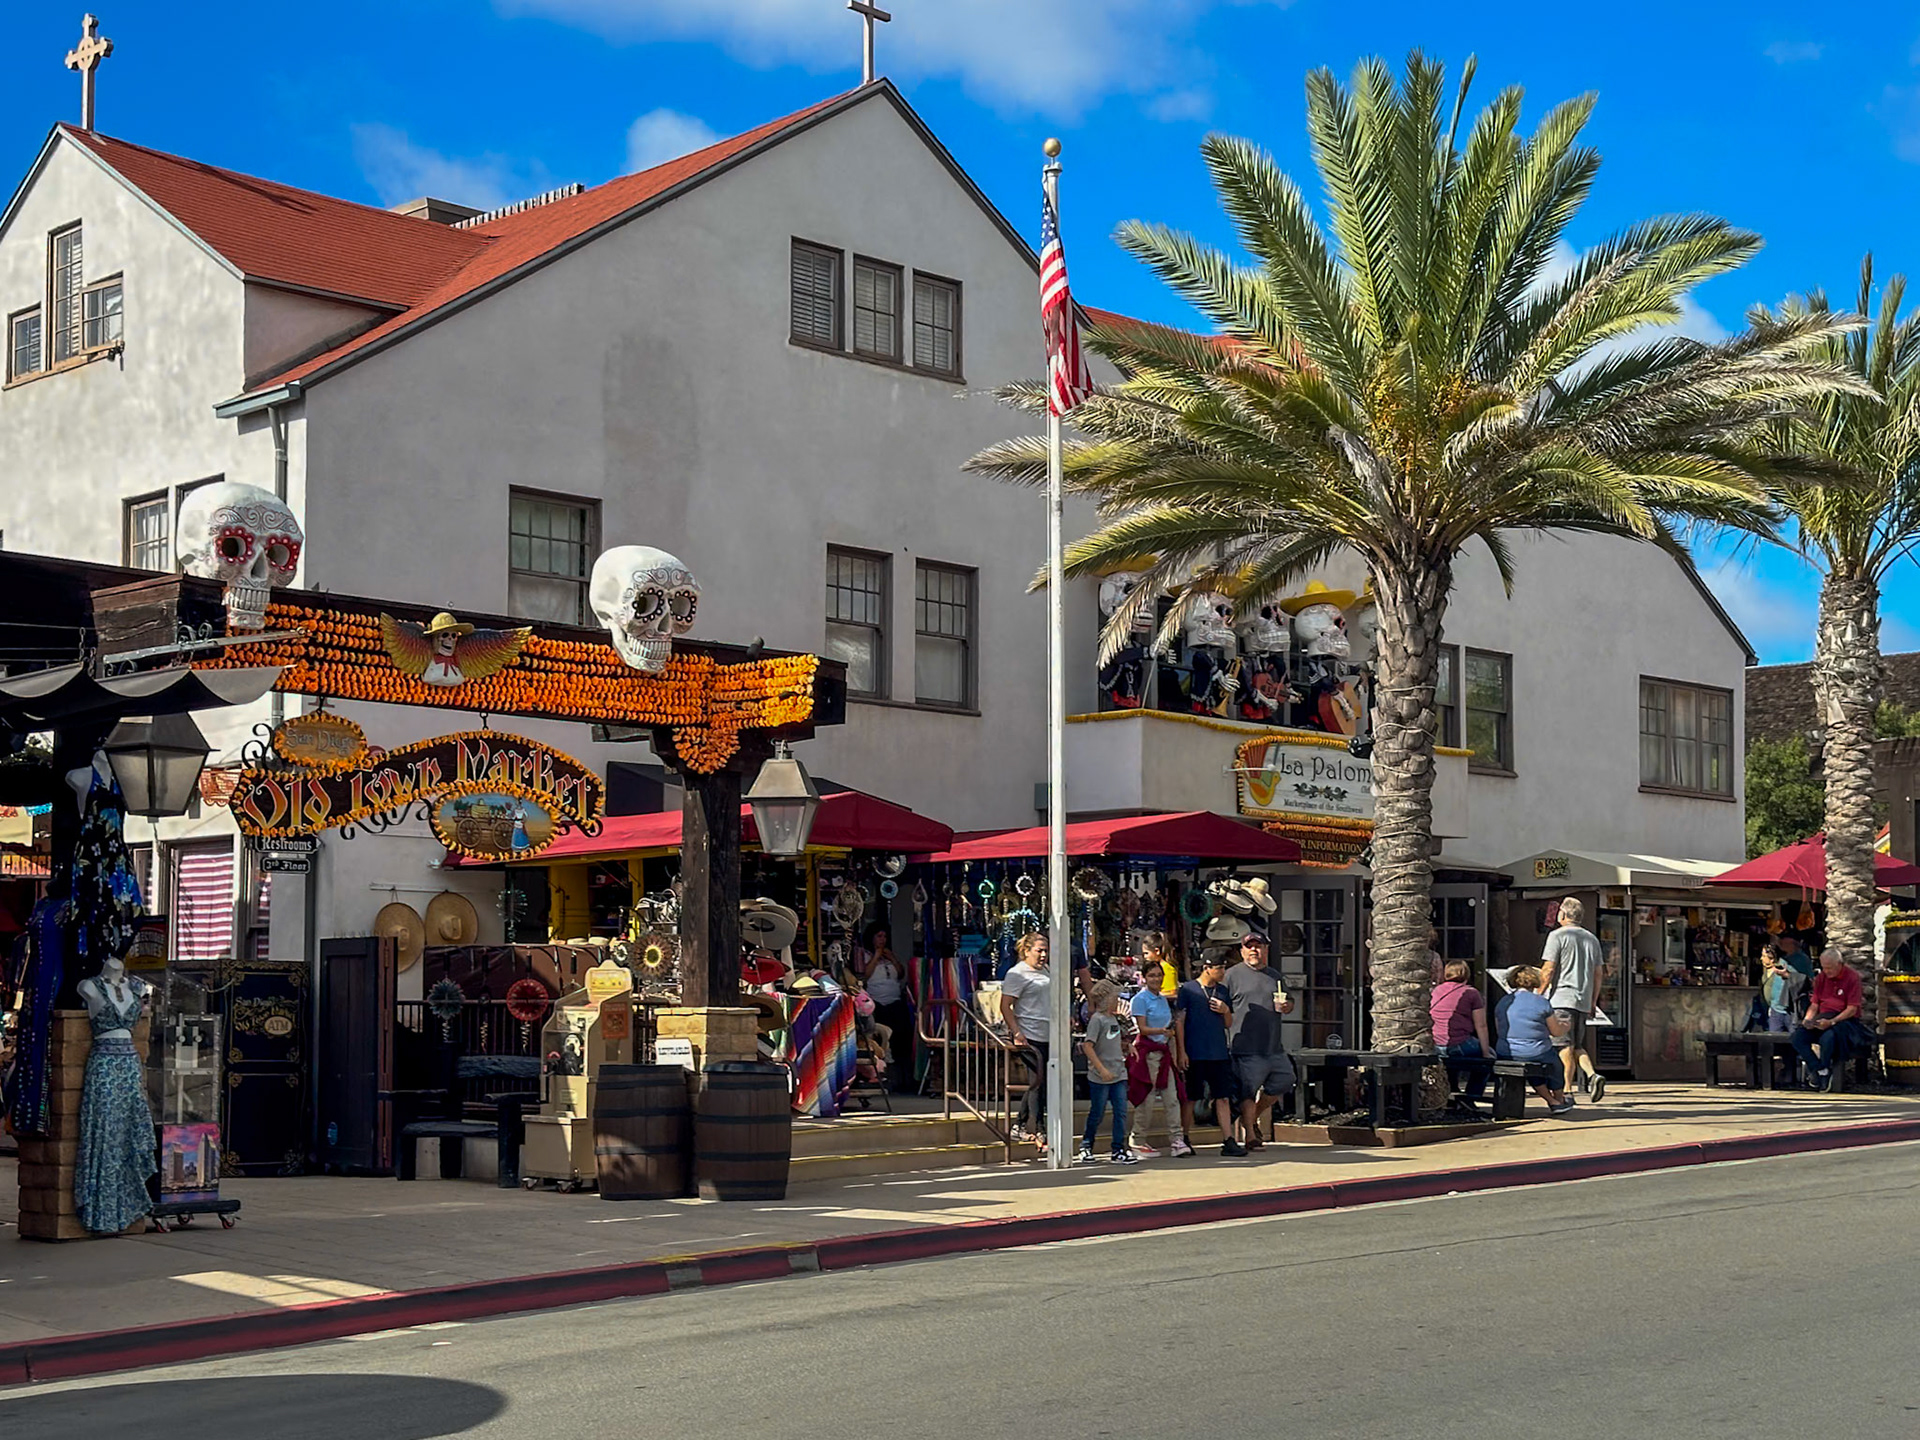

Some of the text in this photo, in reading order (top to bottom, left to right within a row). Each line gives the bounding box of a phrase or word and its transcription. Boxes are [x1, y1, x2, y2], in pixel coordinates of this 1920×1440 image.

[285, 728, 357, 757] San Diego
[1280, 752, 1371, 783] La Palom
[243, 777, 332, 829] Old
[336, 756, 443, 812] Town
[262, 834, 312, 850] Restrooms
[1307, 841, 1363, 854] INFORMATION
[281, 860, 307, 870] Floor
[267, 1020, 289, 1031] ATM
